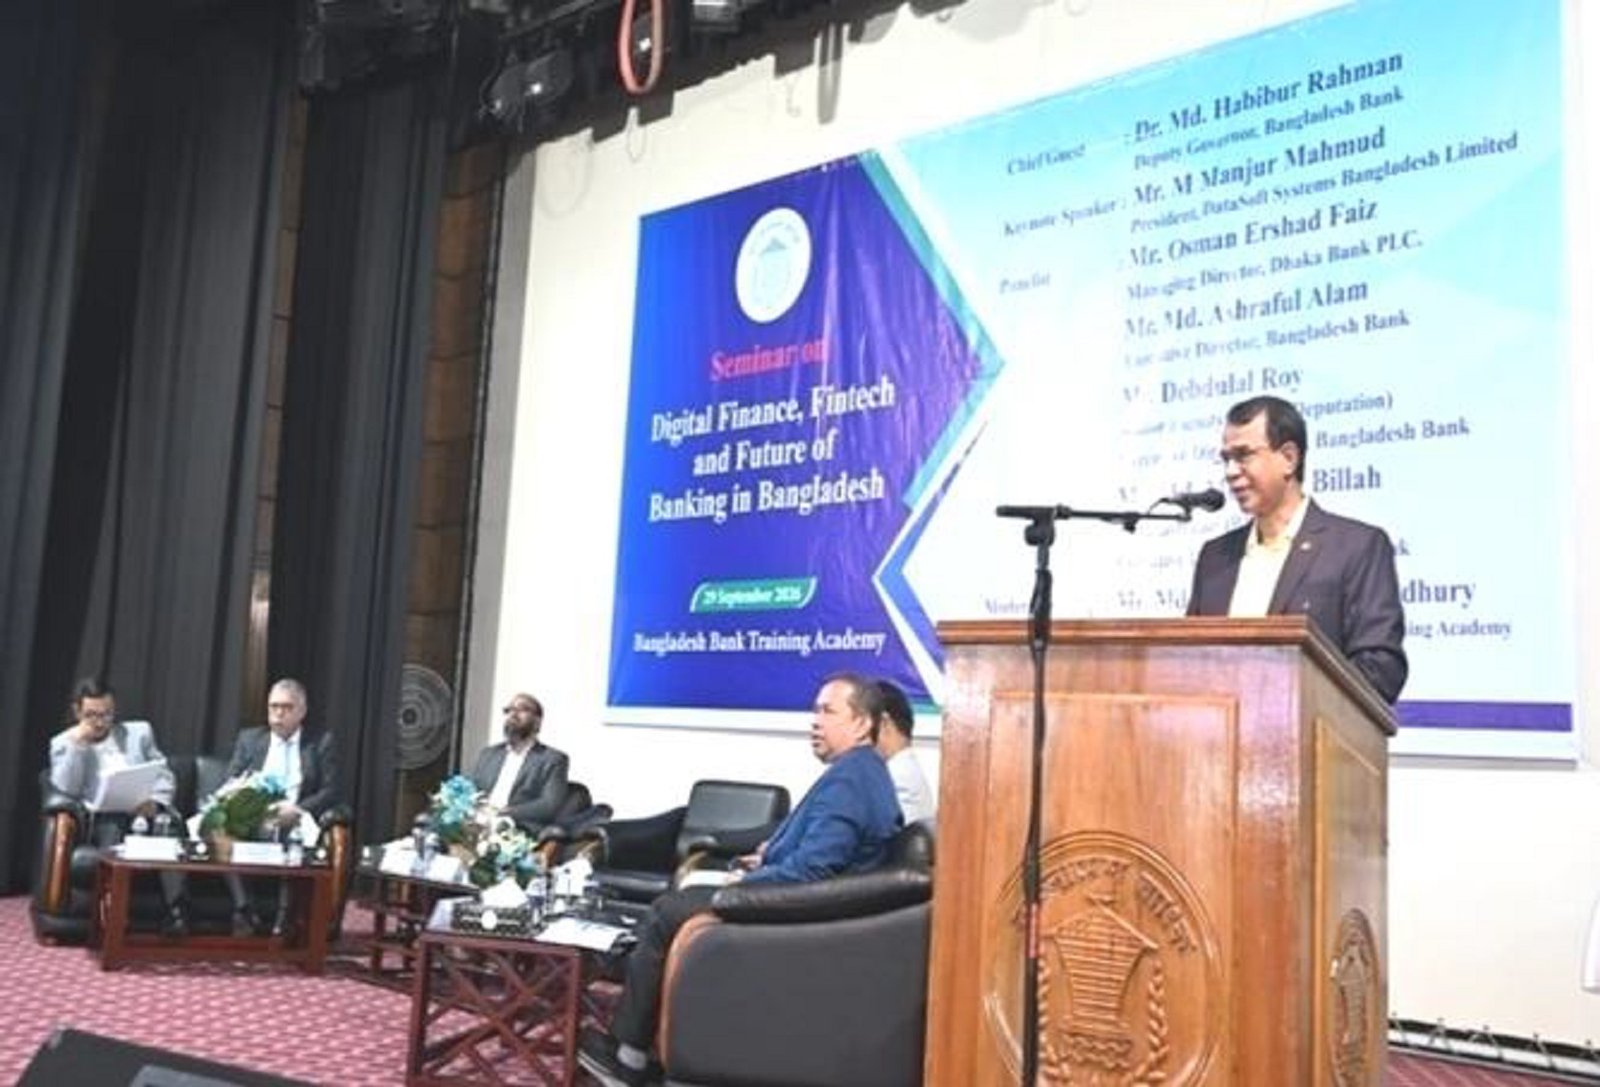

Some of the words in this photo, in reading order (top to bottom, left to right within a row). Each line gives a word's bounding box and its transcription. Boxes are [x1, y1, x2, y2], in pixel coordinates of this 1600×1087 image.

[1168, 104, 1207, 130] Md.
[1213, 81, 1302, 119] Habibur
[1307, 53, 1404, 94] Rahman
[1264, 100, 1355, 136] Bangladesh
[1359, 85, 1405, 112] Bank
[1134, 184, 1165, 204] Mr.
[1173, 173, 1193, 195] M
[1201, 156, 1278, 188] Manjur
[1285, 125, 1386, 168] Mahmud
[1272, 177, 1337, 205] Systems
[1341, 151, 1441, 186] Bangladesh
[1445, 130, 1518, 163] Limited
[1130, 246, 1162, 266] Mr.
[1168, 232, 1237, 261] Osman
[1245, 209, 1322, 245] Ershad
[1329, 198, 1378, 228] Faiz
[1270, 252, 1323, 274] Dhaka
[1328, 240, 1371, 263] Bank
[1376, 230, 1423, 253] PLC.
[1306, 282, 1369, 311] Alam
[1266, 317, 1359, 346] Bangladesh
[1364, 309, 1410, 332] Bank
[711, 345, 799, 380] Seminar
[1261, 366, 1303, 394] Roy
[651, 405, 713, 446] Digital
[717, 398, 804, 433] Finance,
[811, 374, 896, 418] Fintech
[693, 443, 731, 476] and
[735, 440, 807, 471] Future
[812, 427, 838, 460] of
[1316, 422, 1416, 448] Bangladesh
[1422, 416, 1470, 439] Bank
[649, 487, 728, 523] Banking
[731, 484, 752, 513] in
[757, 468, 885, 516] Bangladesh
[1312, 465, 1382, 493] Billah
[1401, 579, 1476, 609] dhury
[633, 631, 707, 657] Bangladesh
[709, 629, 745, 651] Bank
[746, 629, 812, 657] Training
[812, 628, 887, 656] Academy
[1437, 618, 1511, 640] Academy
